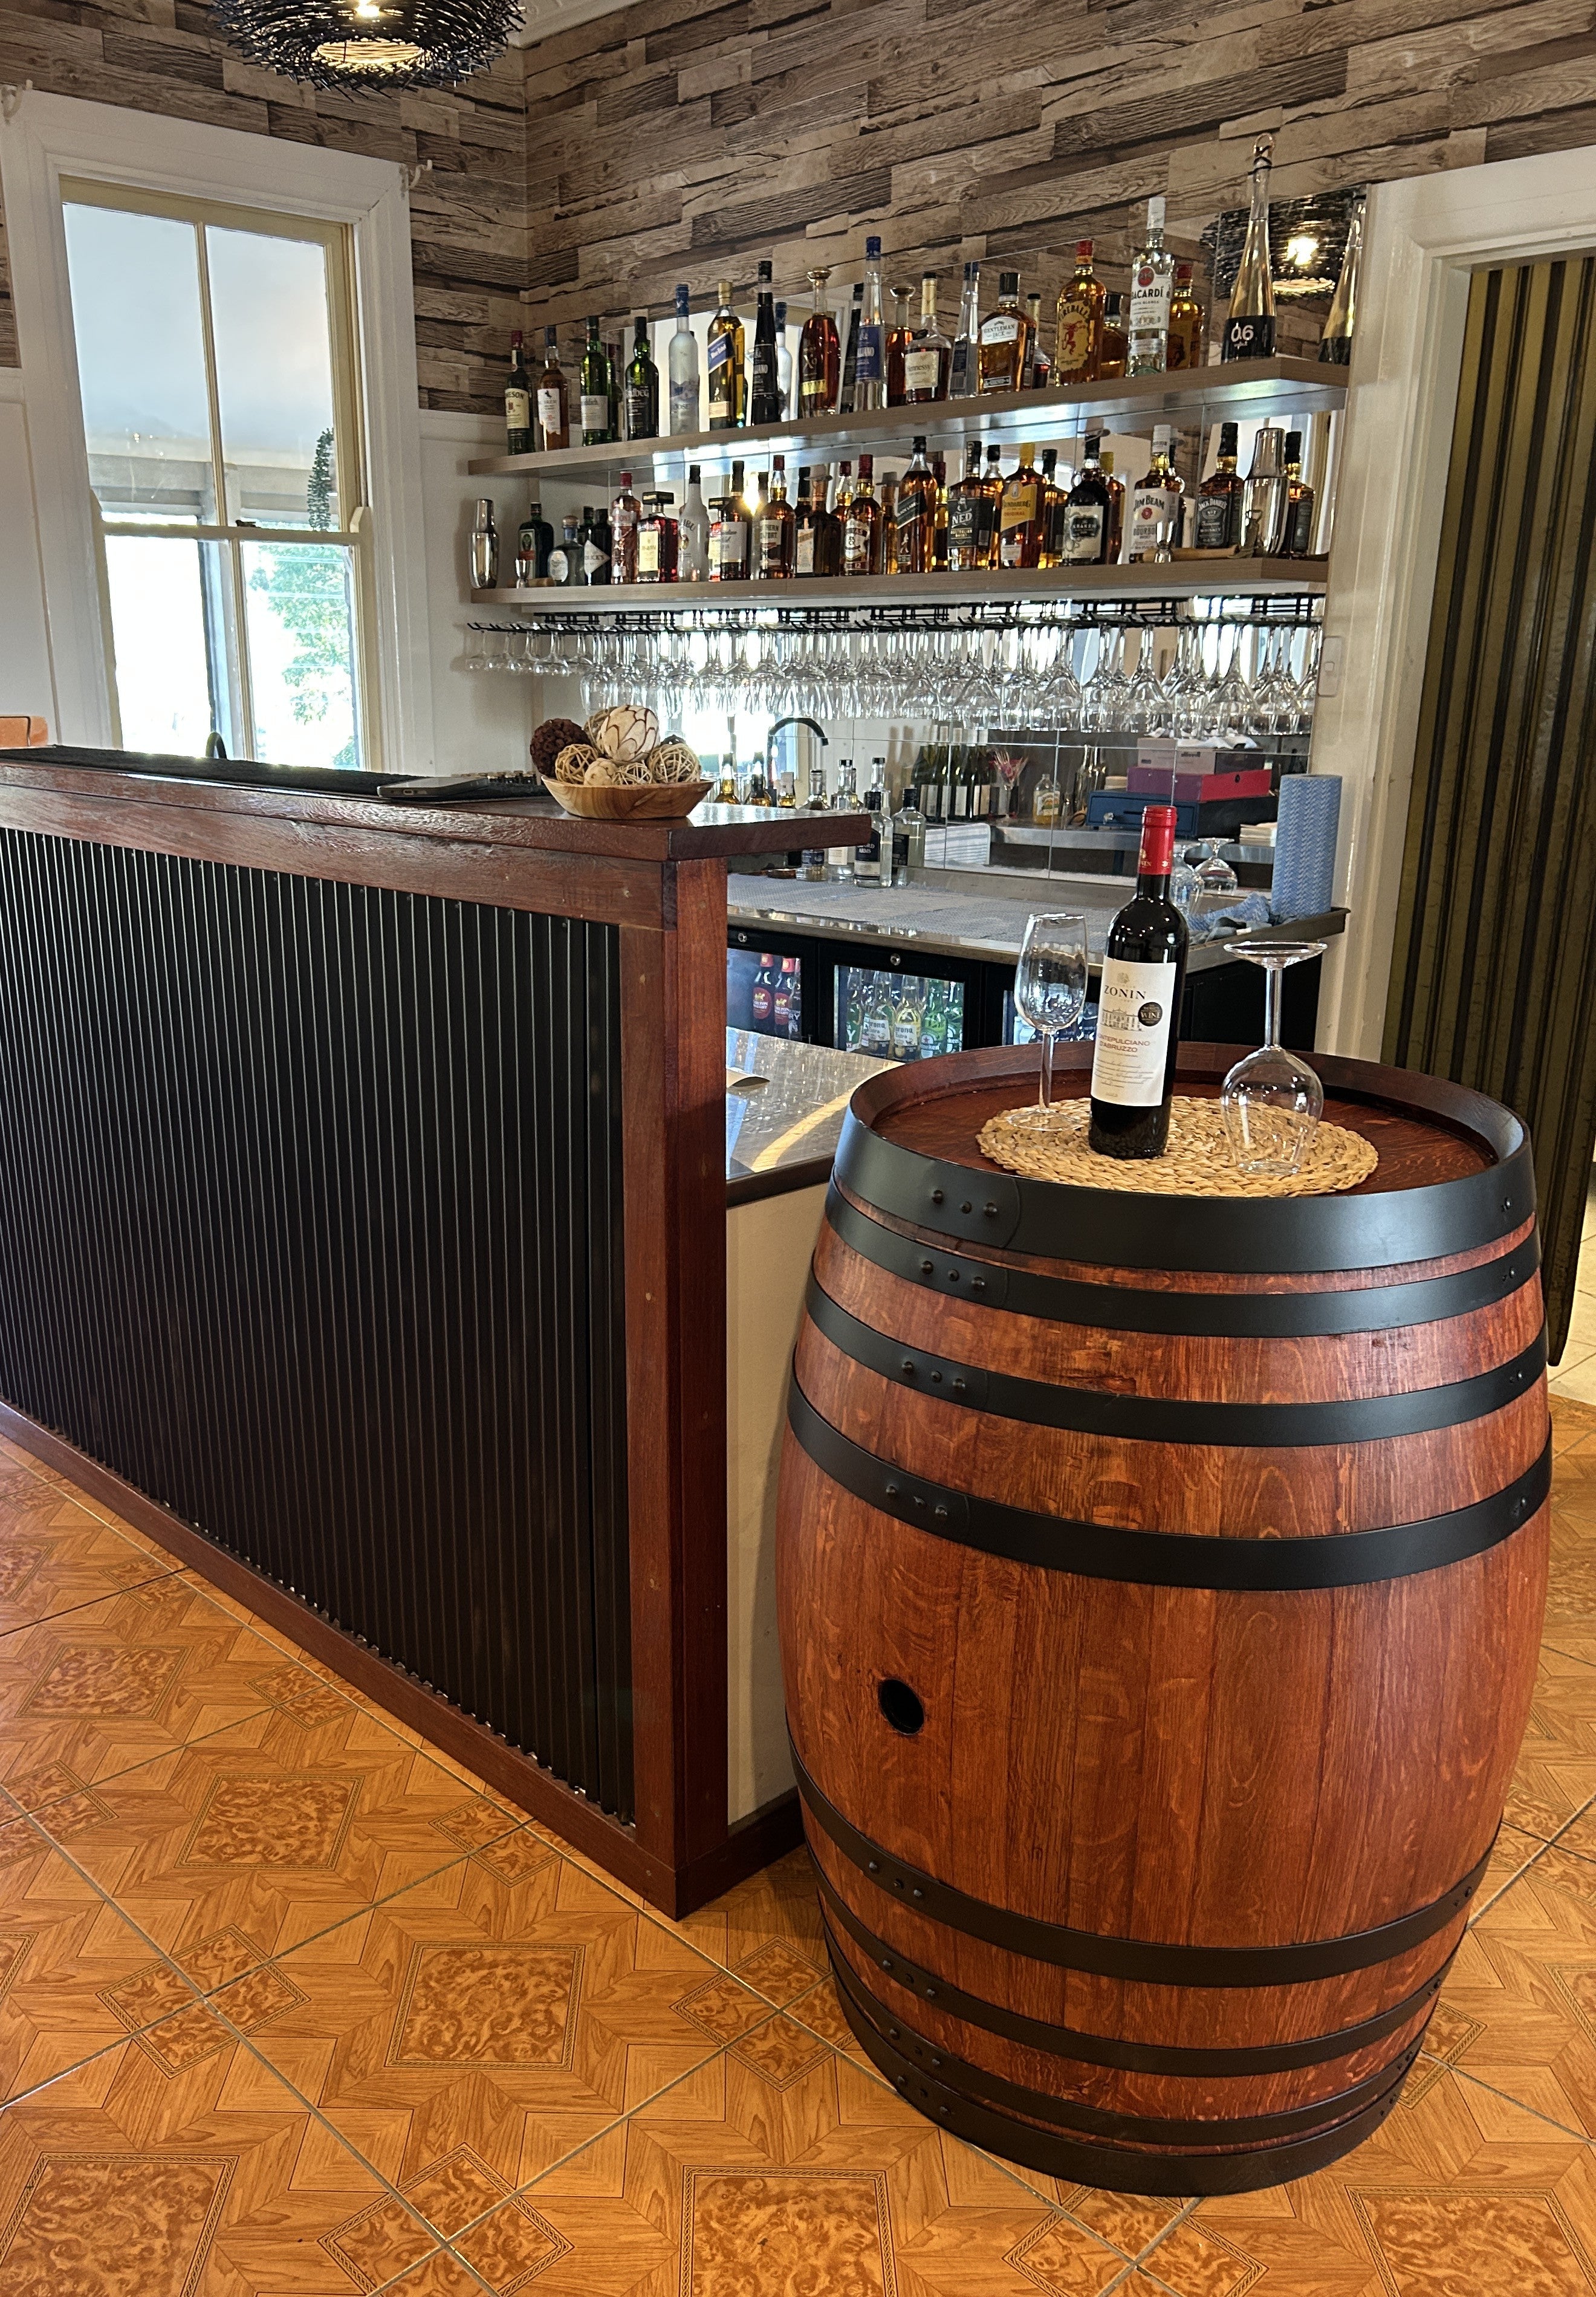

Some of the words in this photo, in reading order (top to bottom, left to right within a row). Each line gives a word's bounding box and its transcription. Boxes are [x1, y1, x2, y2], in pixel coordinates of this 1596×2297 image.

[984, 325, 1015, 334] GENTLEMAN
[1134, 498, 1145, 511] JIM
[1145, 494, 1164, 510] BEAM
[952, 512, 973, 525] NED
[1104, 985, 1146, 1000] ZONIN
